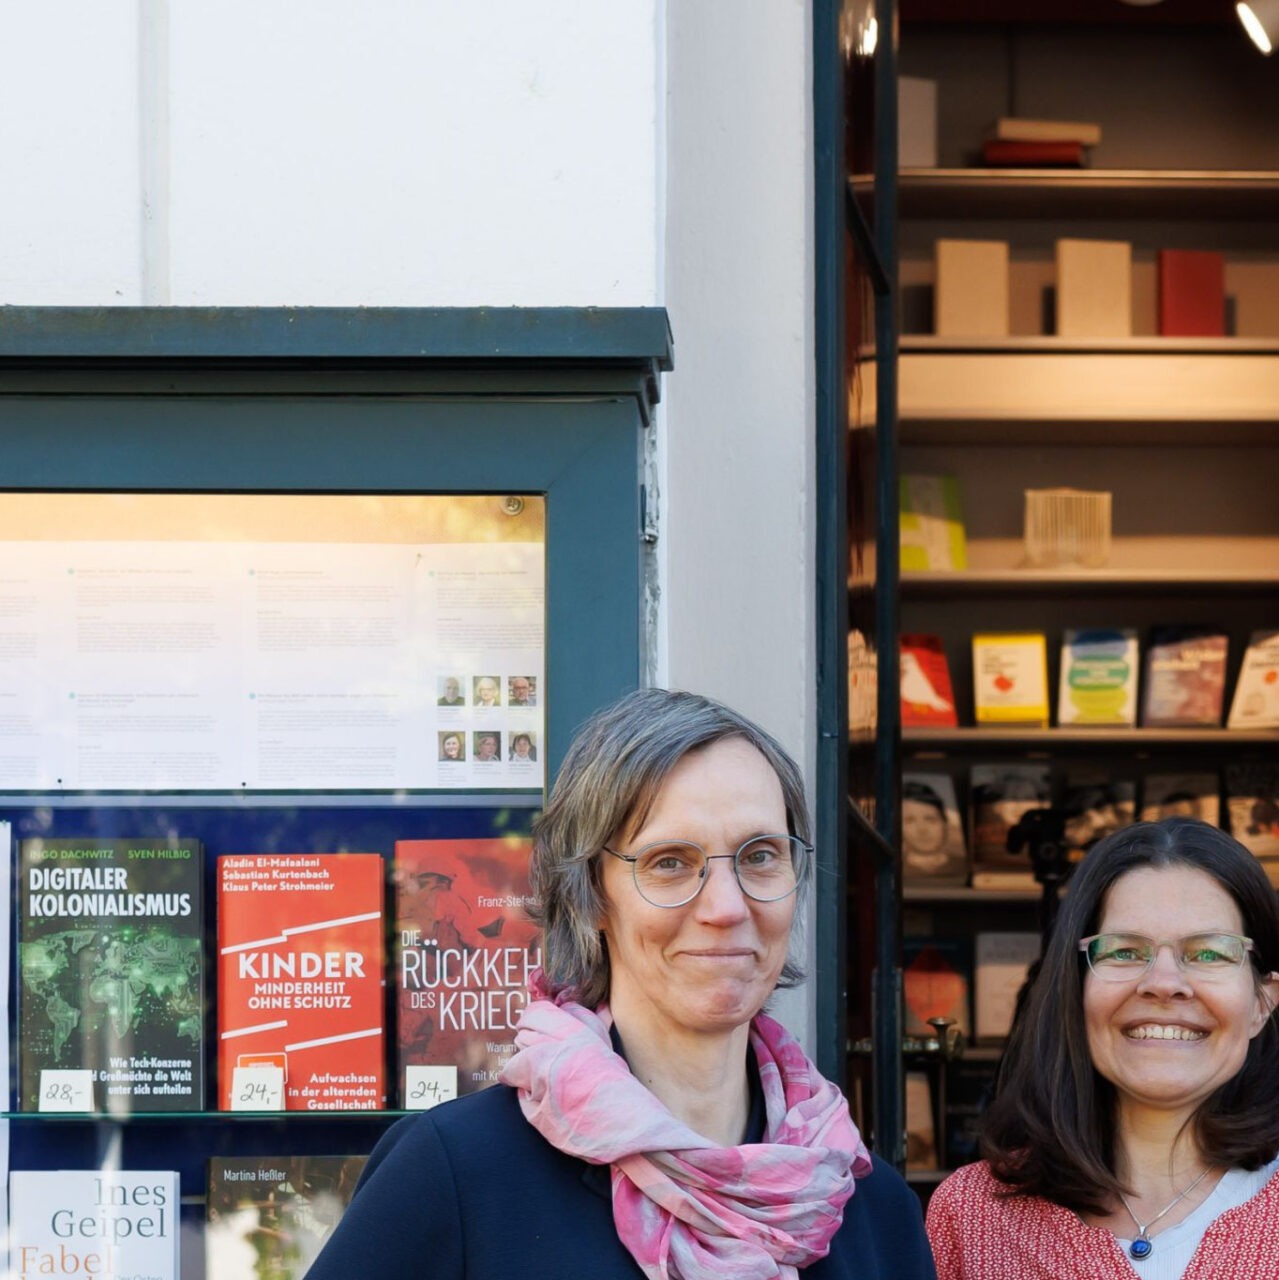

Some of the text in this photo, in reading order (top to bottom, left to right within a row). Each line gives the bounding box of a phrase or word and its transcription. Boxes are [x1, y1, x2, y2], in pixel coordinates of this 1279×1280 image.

[61, 849, 114, 860] DACHWITZ
[127, 849, 155, 860] SVEN
[157, 849, 191, 860] HILBIG
[222, 857, 320, 868] Aladin El-Mafaalani
[29, 867, 128, 891] DIGITALER
[222, 869, 330, 880] Sebastian Kurtenbach
[222, 881, 335, 892] Klaus Peter Strohmeier
[29, 893, 192, 917] KOLONIALISMUS
[401, 929, 422, 948] DIE
[238, 951, 366, 980] KINDER
[254, 981, 346, 995] MINDERHEIT
[247, 995, 352, 1010] OHNE SCHUTZ
[410, 991, 436, 1009] DES
[440, 990, 531, 1031] KRIEG
[486, 1041, 517, 1053] Warum
[110, 1056, 192, 1068] Wie Tech-Konzerne
[154, 1070, 168, 1081] die
[170, 1070, 192, 1081] Welt
[309, 1072, 377, 1084] Aufwachsen
[472, 1069, 487, 1081] mit
[108, 1083, 192, 1095] unter sich aufteilen
[288, 1086, 377, 1097] in der alternden
[307, 1098, 377, 1110] Gesellschaft
[223, 1168, 287, 1181] Martina Heßler
[93, 1177, 167, 1207] Ines
[51, 1207, 168, 1247] Geipel
[18, 1243, 115, 1275] Fabel
